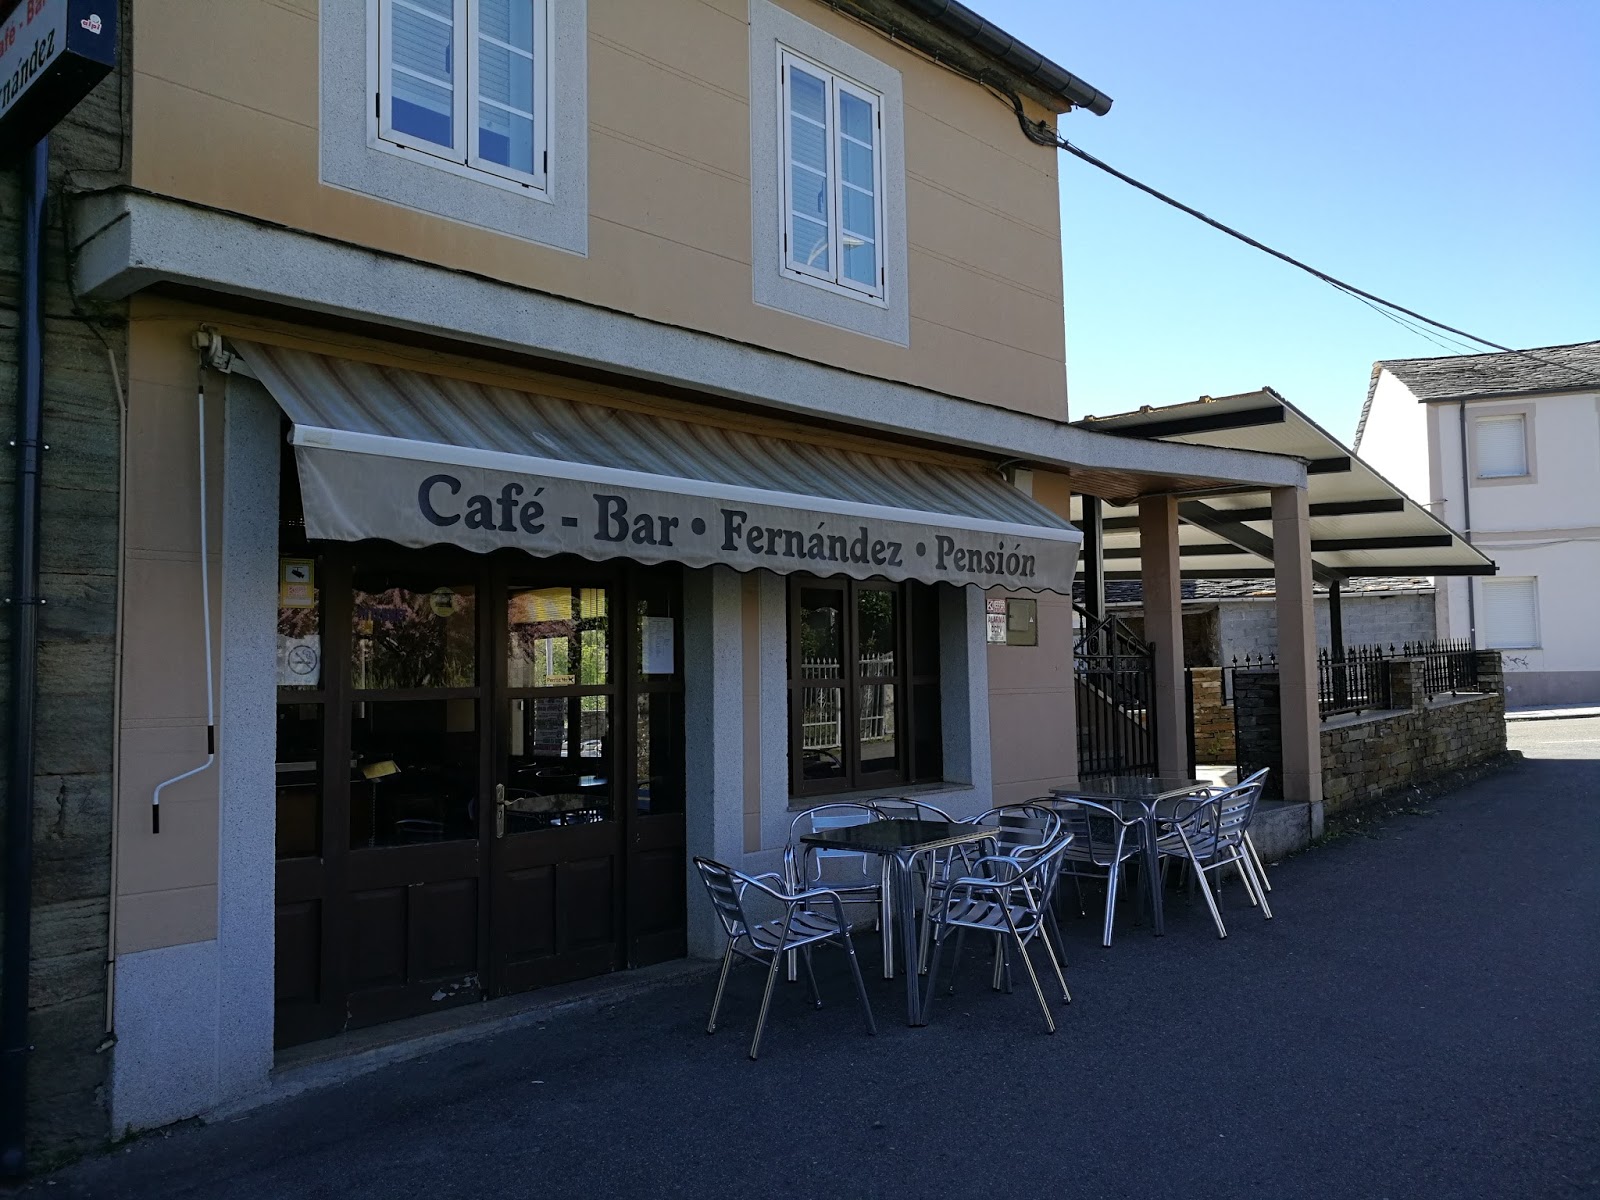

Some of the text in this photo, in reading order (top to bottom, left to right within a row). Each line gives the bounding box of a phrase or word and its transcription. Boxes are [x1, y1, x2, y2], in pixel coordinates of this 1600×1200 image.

[0, 20, 16, 57] afé
[0, 28, 56, 109] nández
[417, 474, 545, 535] Café
[593, 493, 679, 547] Bar
[720, 508, 903, 567] Fernández
[935, 534, 1036, 578] Pensión
